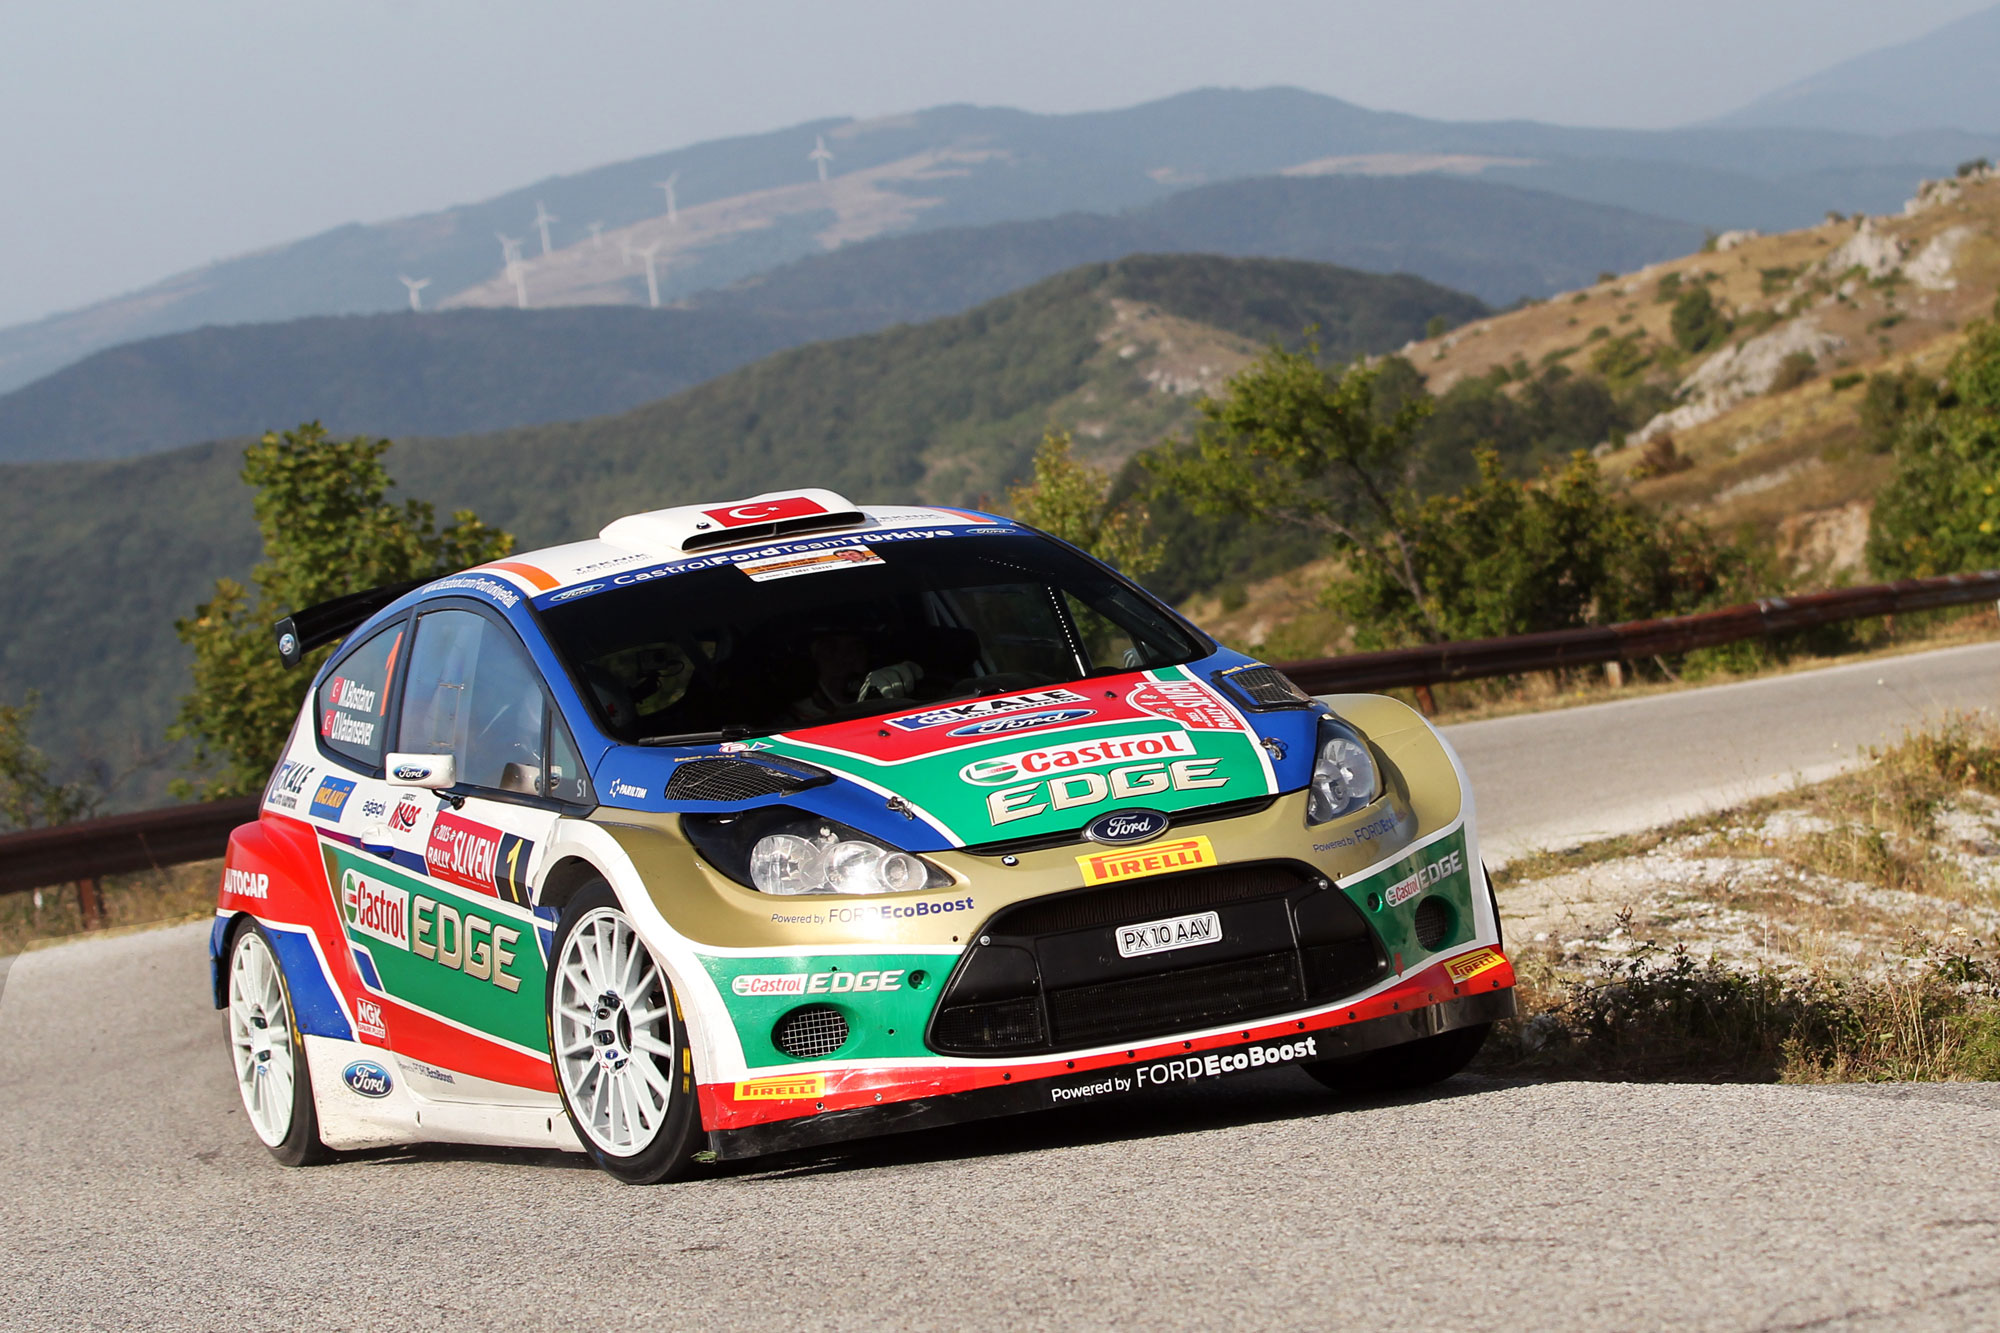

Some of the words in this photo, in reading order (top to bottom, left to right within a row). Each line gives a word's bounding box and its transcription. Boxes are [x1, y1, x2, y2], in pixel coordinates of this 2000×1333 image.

[380, 631, 402, 716] 1
[950, 691, 1075, 716] KALE
[978, 712, 1070, 732] Ford
[1022, 735, 1184, 773] Castrol
[398, 766, 425, 780] Ford
[576, 779, 587, 798] S1
[986, 757, 1231, 826] EDGE
[1107, 814, 1152, 837] Ford
[451, 830, 496, 883] SLIVEN
[1312, 837, 1346, 852] Powered
[428, 846, 451, 869] RALLY
[1091, 841, 1202, 880] PIRELLI
[223, 867, 270, 899] AUTOCAR
[506, 838, 524, 903] 1
[1395, 875, 1420, 901] Castrol
[1419, 849, 1463, 889] EDGE
[771, 913, 812, 924] Powered
[813, 914, 825, 925] by
[1177, 918, 1211, 941] AAV
[357, 880, 406, 942] Castrol
[412, 895, 522, 993] EDGE
[1450, 953, 1497, 975] PIRELLI
[750, 977, 802, 993] Castrol
[806, 969, 905, 994] EDGE
[359, 1001, 385, 1027] NGK
[353, 1065, 386, 1093] Ford
[1051, 1077, 1112, 1102] Powered
[1115, 1075, 1131, 1093] by
[1136, 1037, 1317, 1088] FORDEcoBoost
[743, 1079, 816, 1096] PIRELLI
